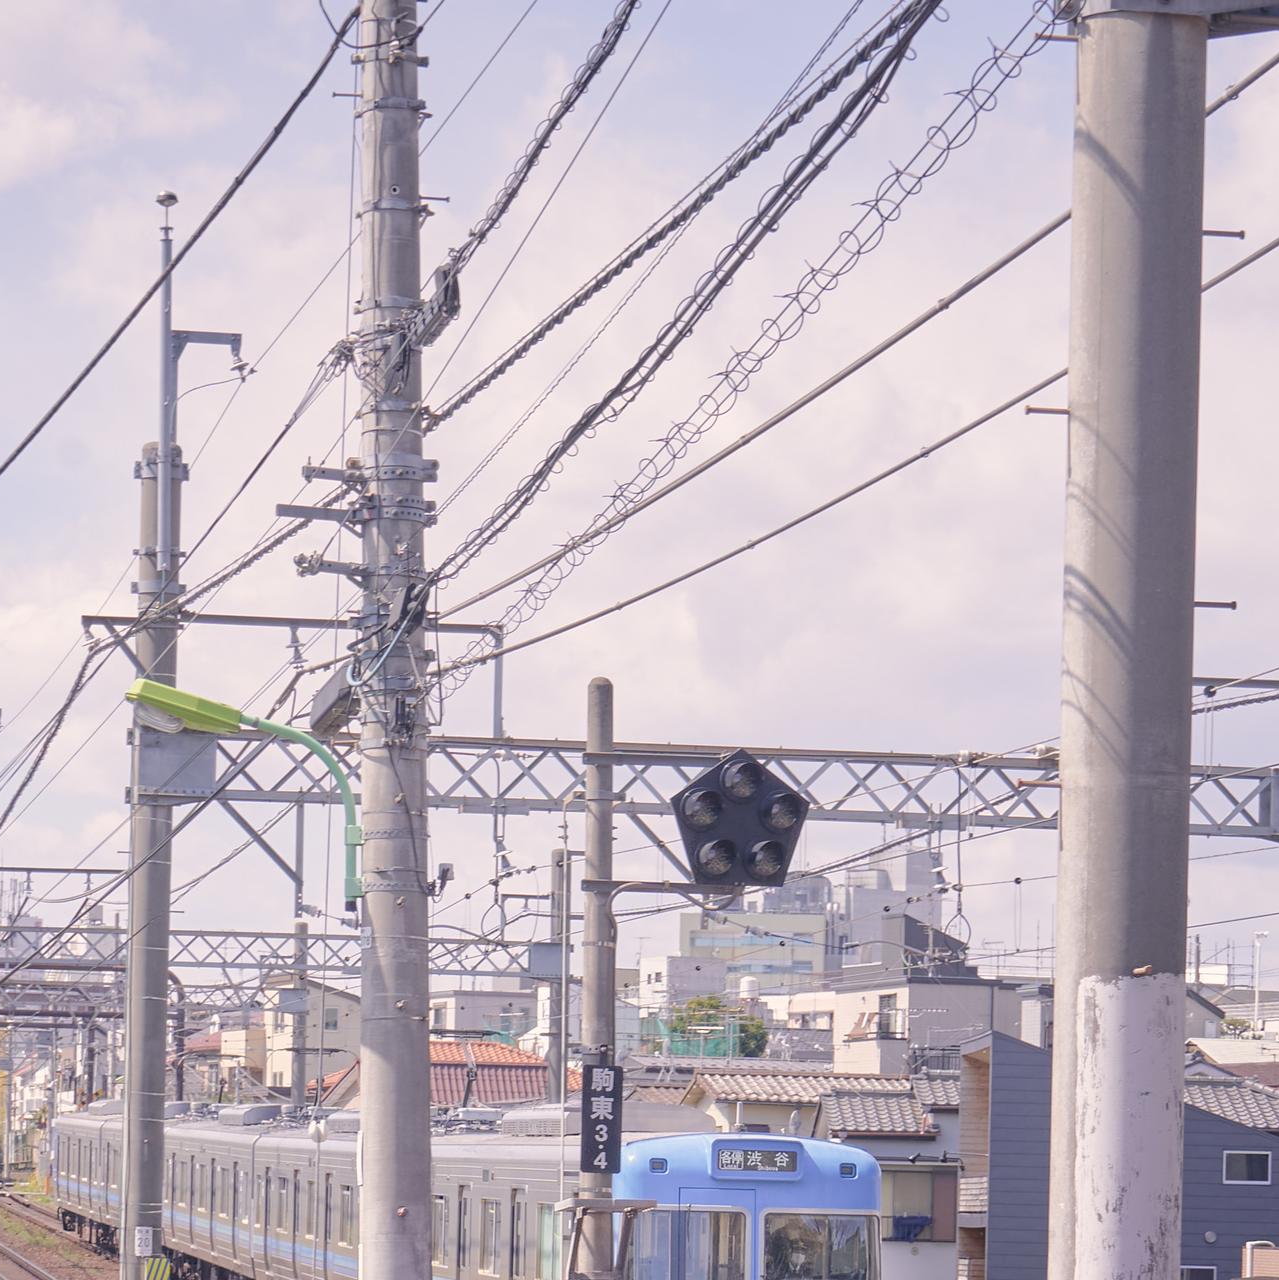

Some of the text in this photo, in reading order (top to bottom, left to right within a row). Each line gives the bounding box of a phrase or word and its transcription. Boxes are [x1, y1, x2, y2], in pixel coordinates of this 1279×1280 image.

[721, 1151, 743, 1164] 各停
[746, 1151, 790, 1167] 渋谷
[137, 1237, 150, 1248] 20
